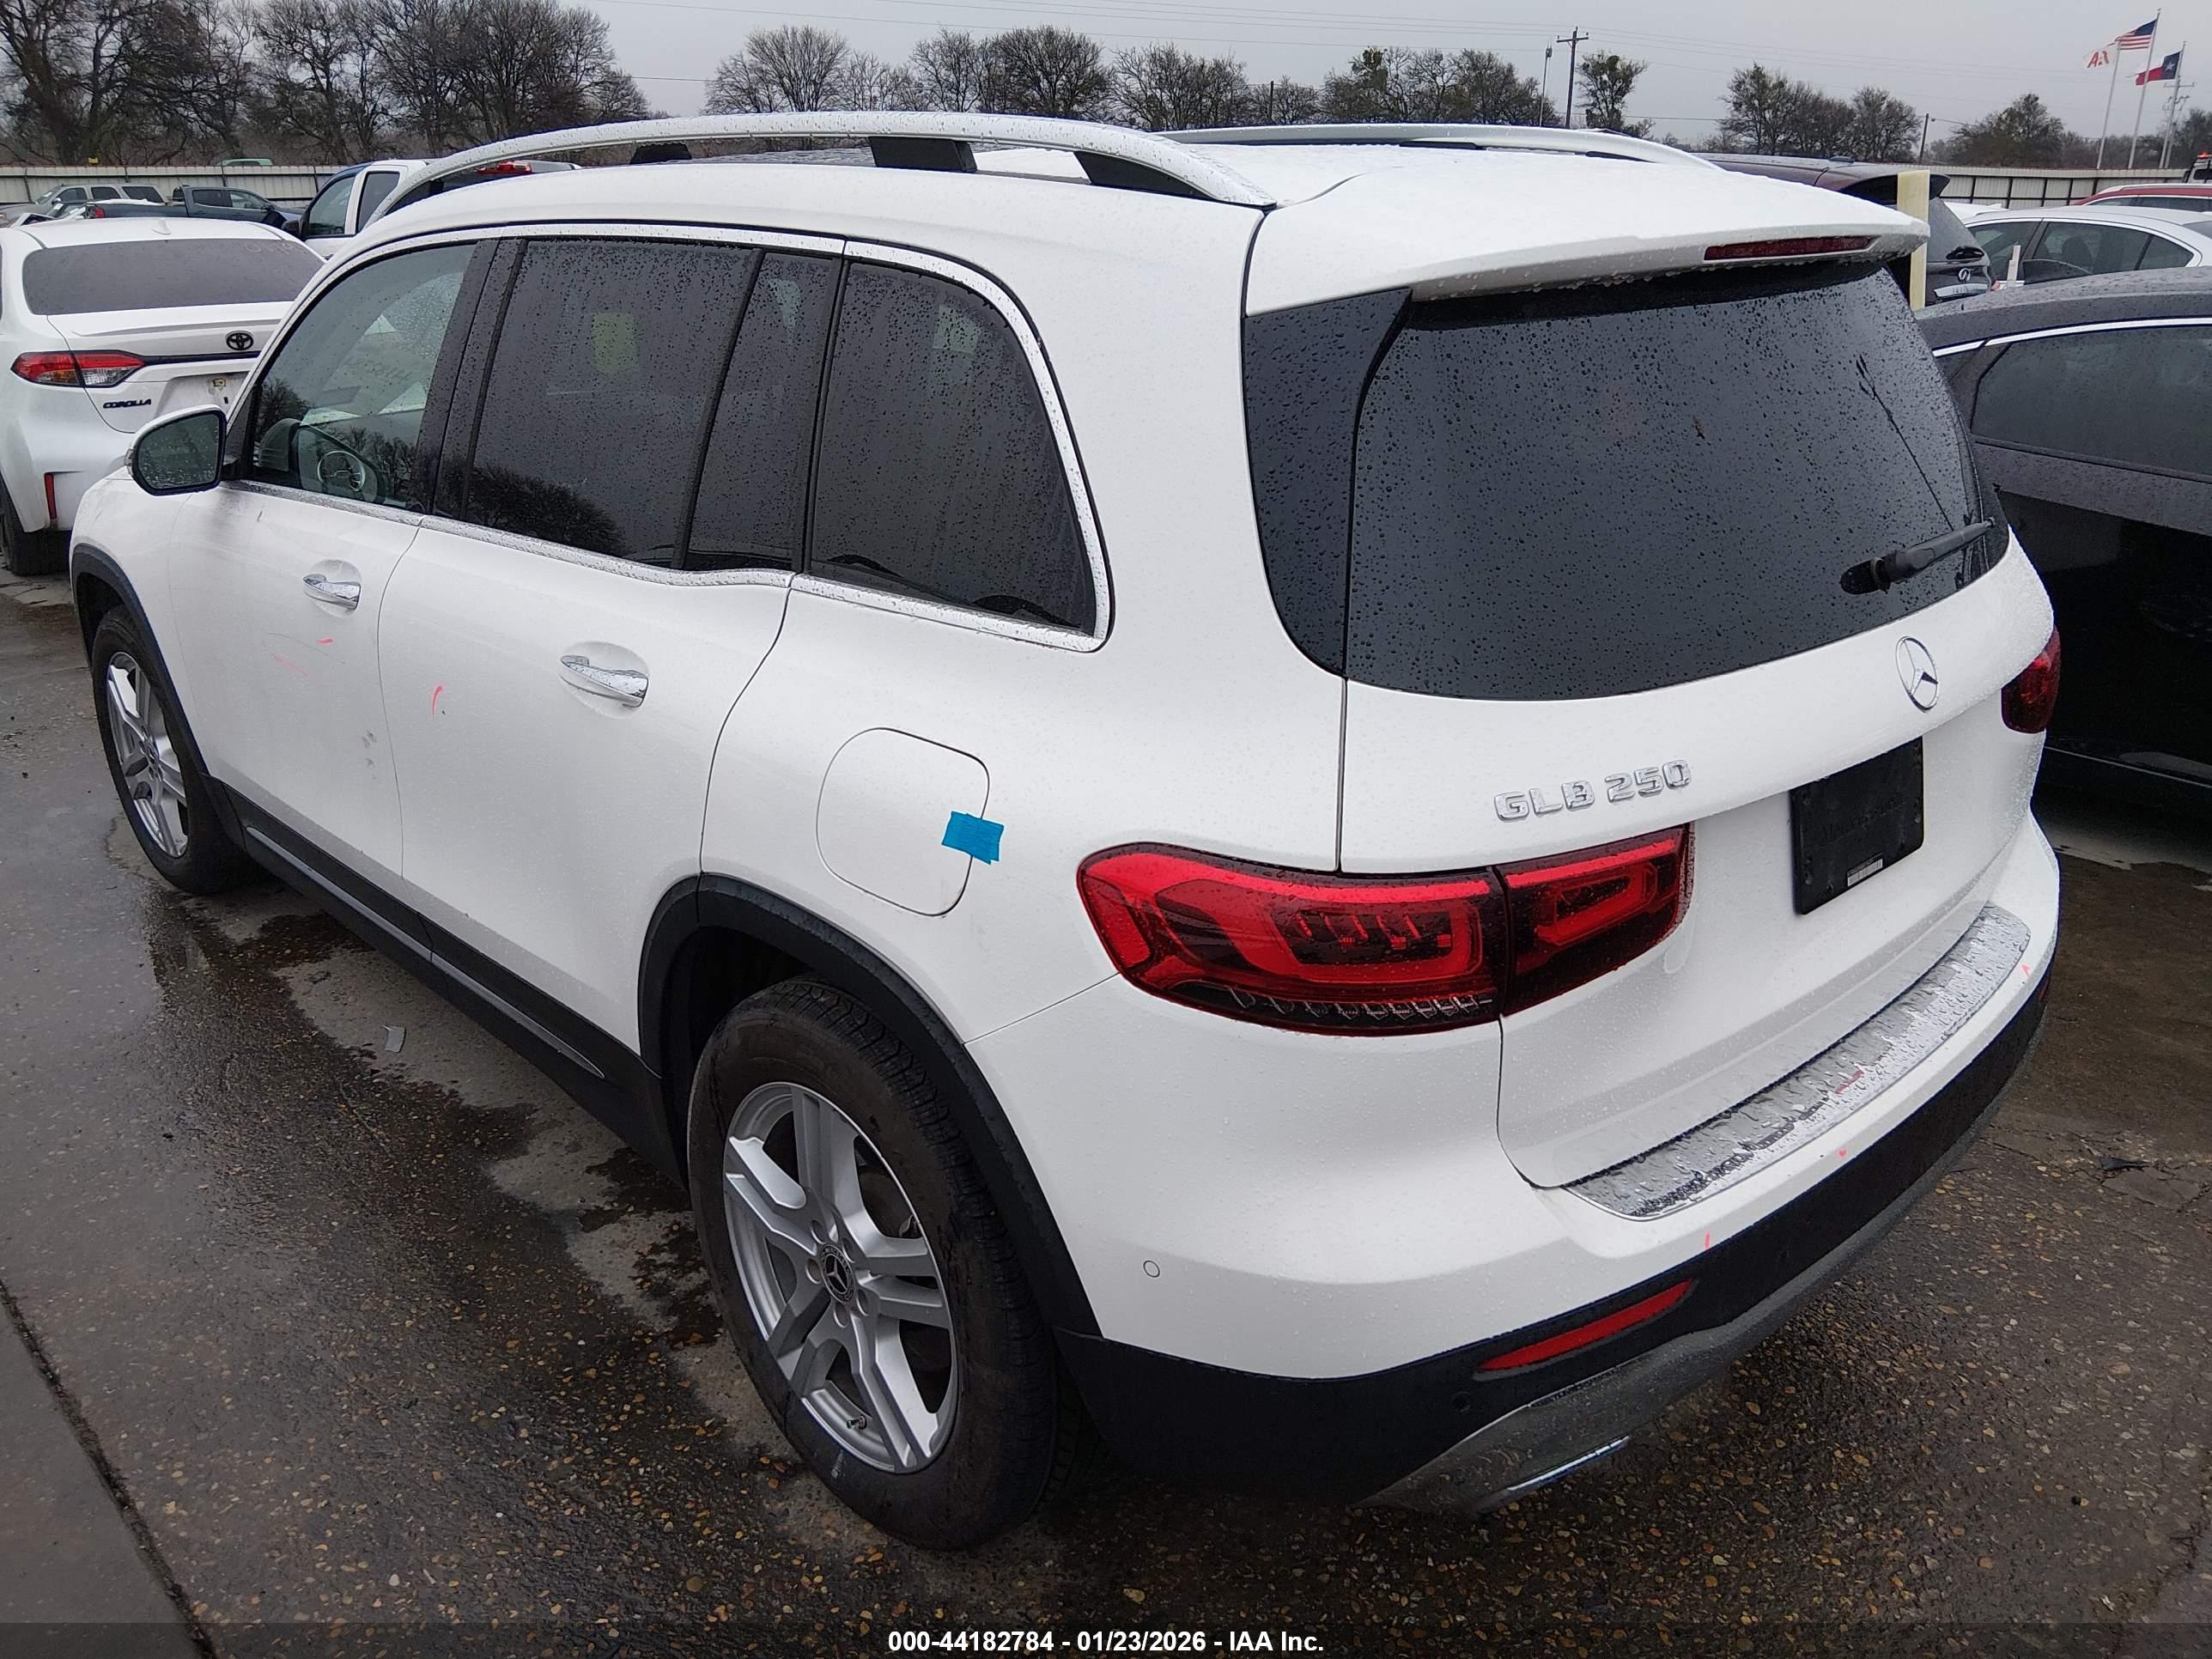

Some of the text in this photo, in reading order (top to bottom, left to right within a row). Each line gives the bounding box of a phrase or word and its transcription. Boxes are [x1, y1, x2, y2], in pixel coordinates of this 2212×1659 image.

[103, 398, 151, 409] COROLLA
[1494, 759, 1692, 821] GLB 250
